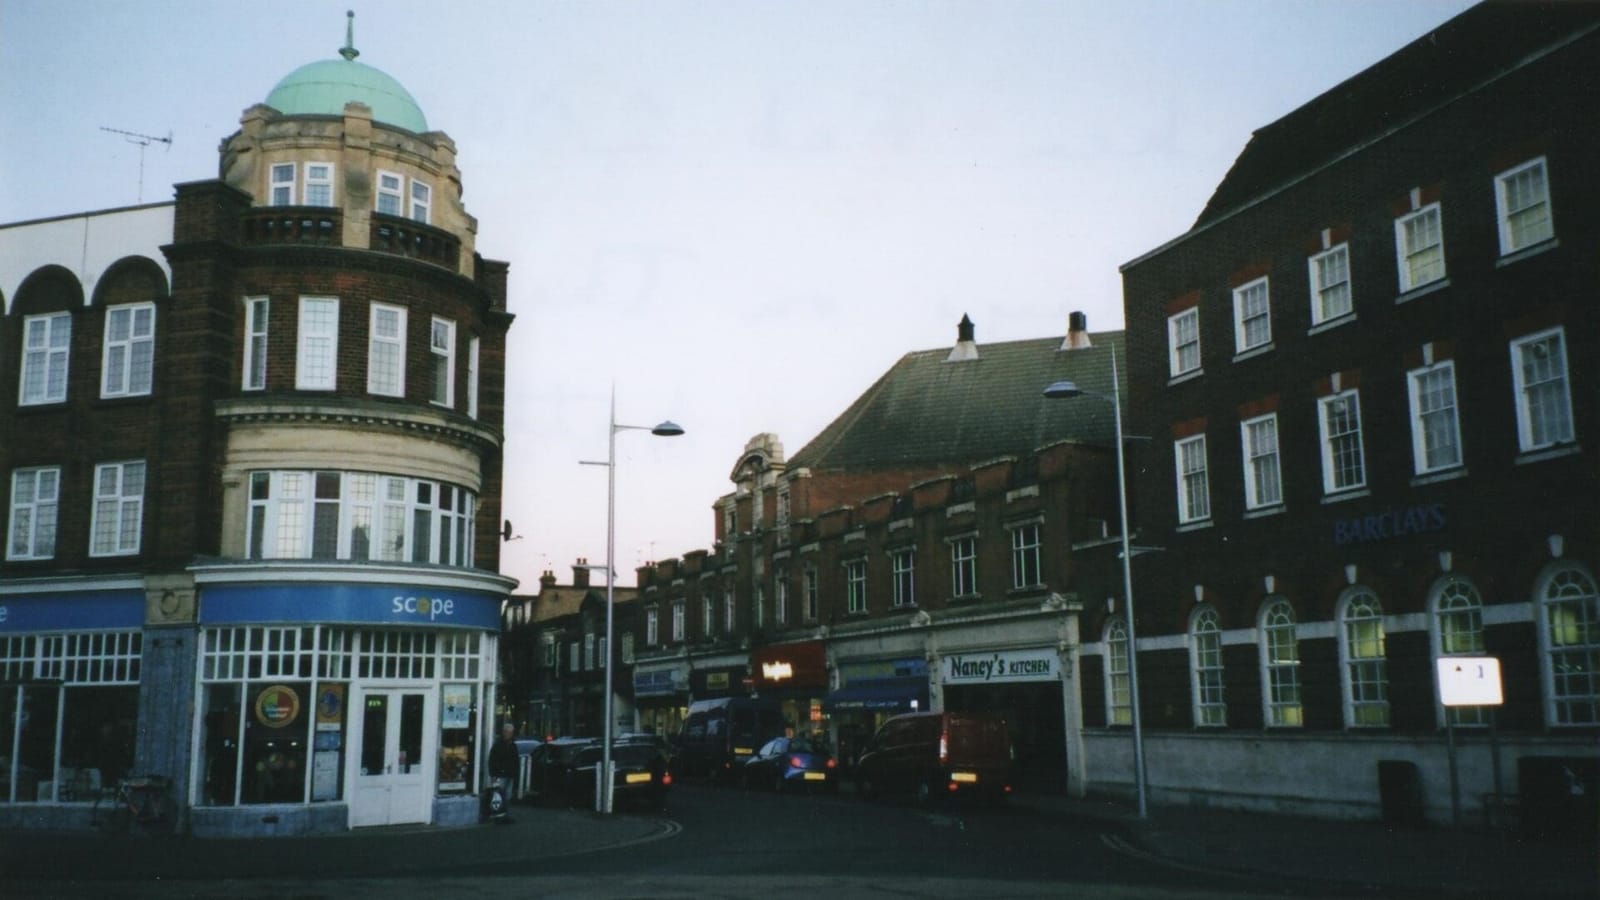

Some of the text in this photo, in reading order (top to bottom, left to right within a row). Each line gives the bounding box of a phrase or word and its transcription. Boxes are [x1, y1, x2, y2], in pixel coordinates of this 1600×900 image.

[1335, 503, 1447, 544] BARCLAYS
[391, 596, 454, 621] scope
[951, 653, 1050, 680] Nancy's KITCHEN
